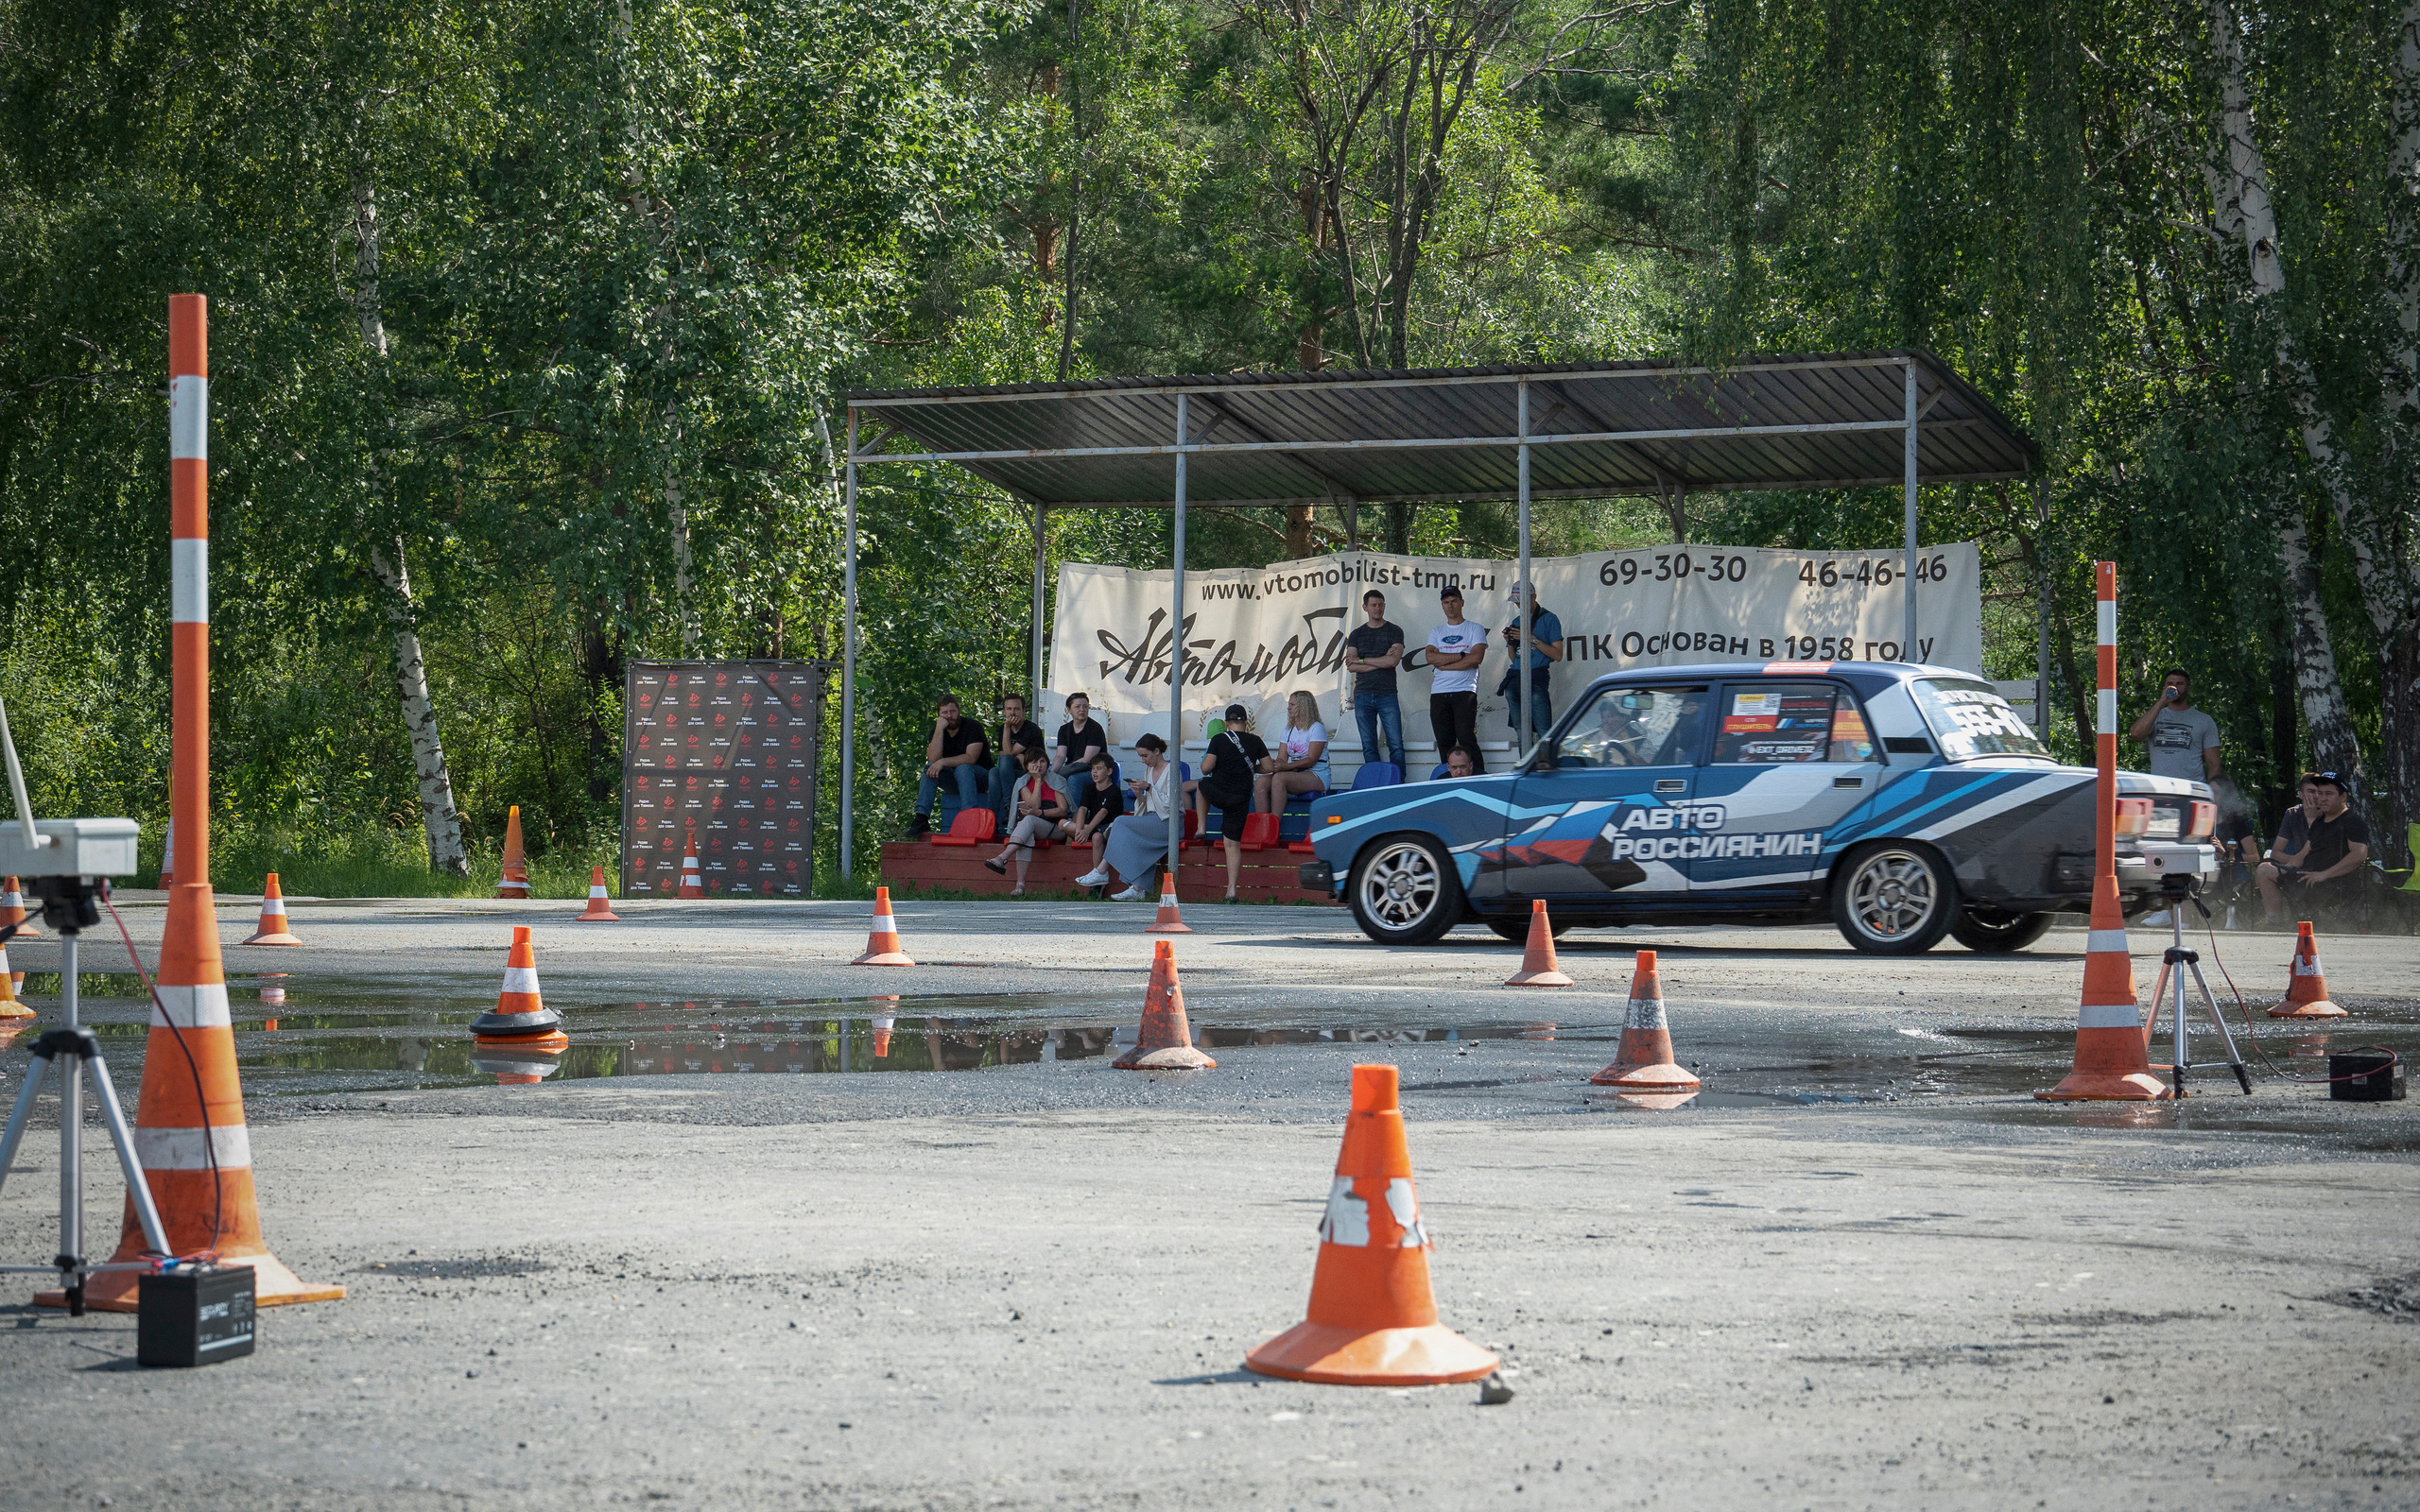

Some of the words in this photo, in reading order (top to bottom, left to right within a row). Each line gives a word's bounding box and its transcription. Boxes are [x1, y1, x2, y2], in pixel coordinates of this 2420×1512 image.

[1599, 552, 1747, 586] 69-30-30
[1798, 554, 1947, 588] 46-46-46
[1621, 630, 1749, 658] Основан
[1759, 638, 1775, 658] в
[1784, 635, 1854, 662] 1958
[1620, 806, 1726, 831] АВТО
[1612, 833, 1823, 860] РОССИЯНИН
